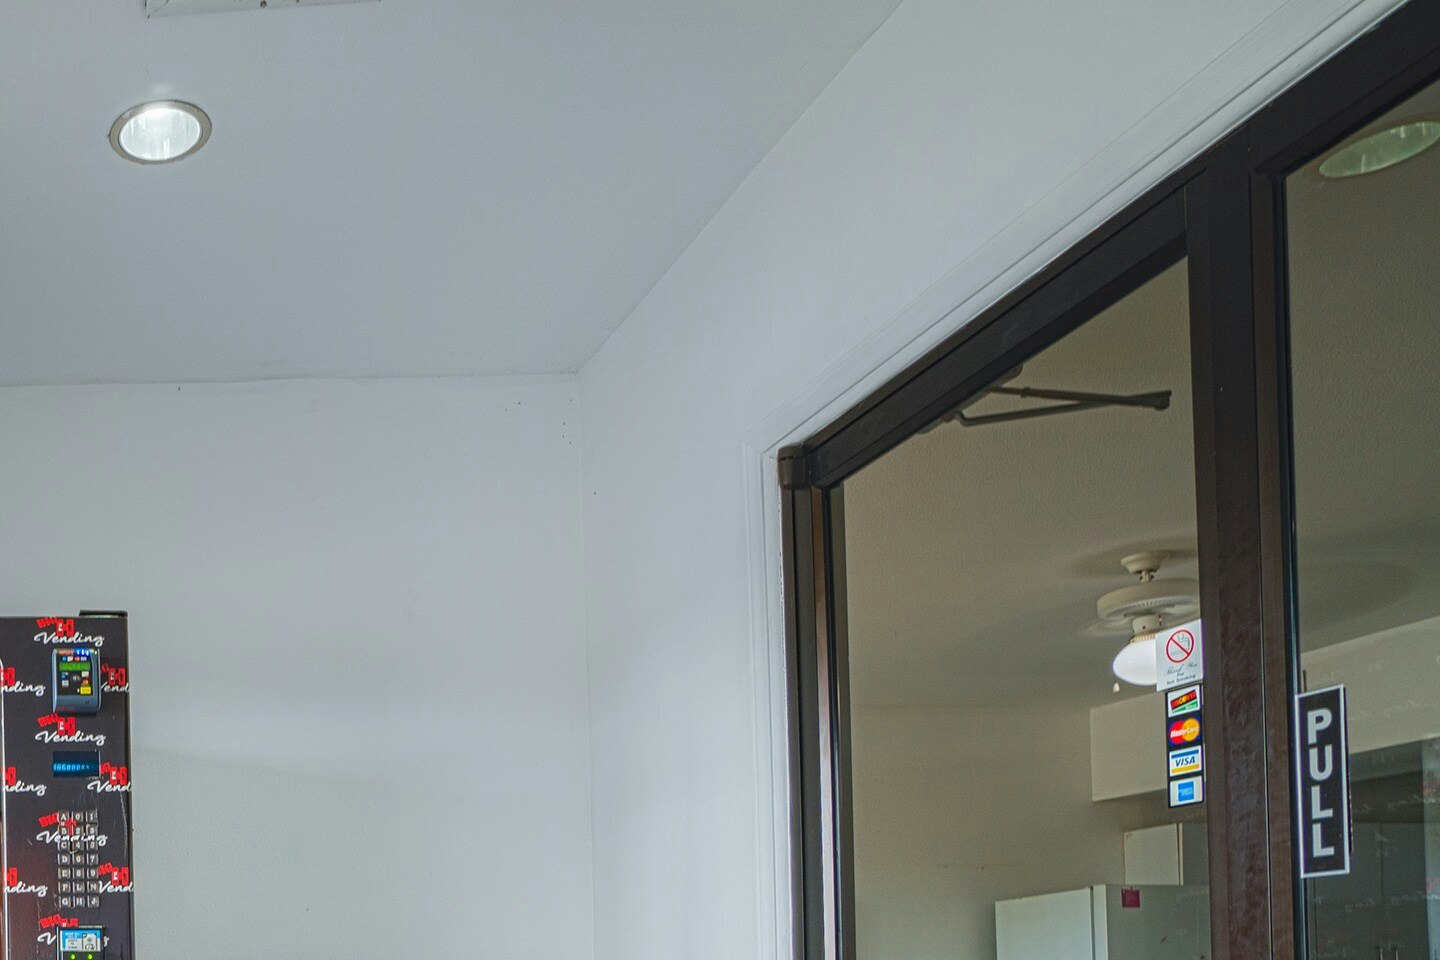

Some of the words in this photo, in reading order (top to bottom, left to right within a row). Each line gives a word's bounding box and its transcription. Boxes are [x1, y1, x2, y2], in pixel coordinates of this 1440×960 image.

[34, 630, 105, 648] Vending
[35, 730, 107, 746] Vending
[1175, 756, 1196, 767] VISA
[1307, 707, 1335, 858] PULL
